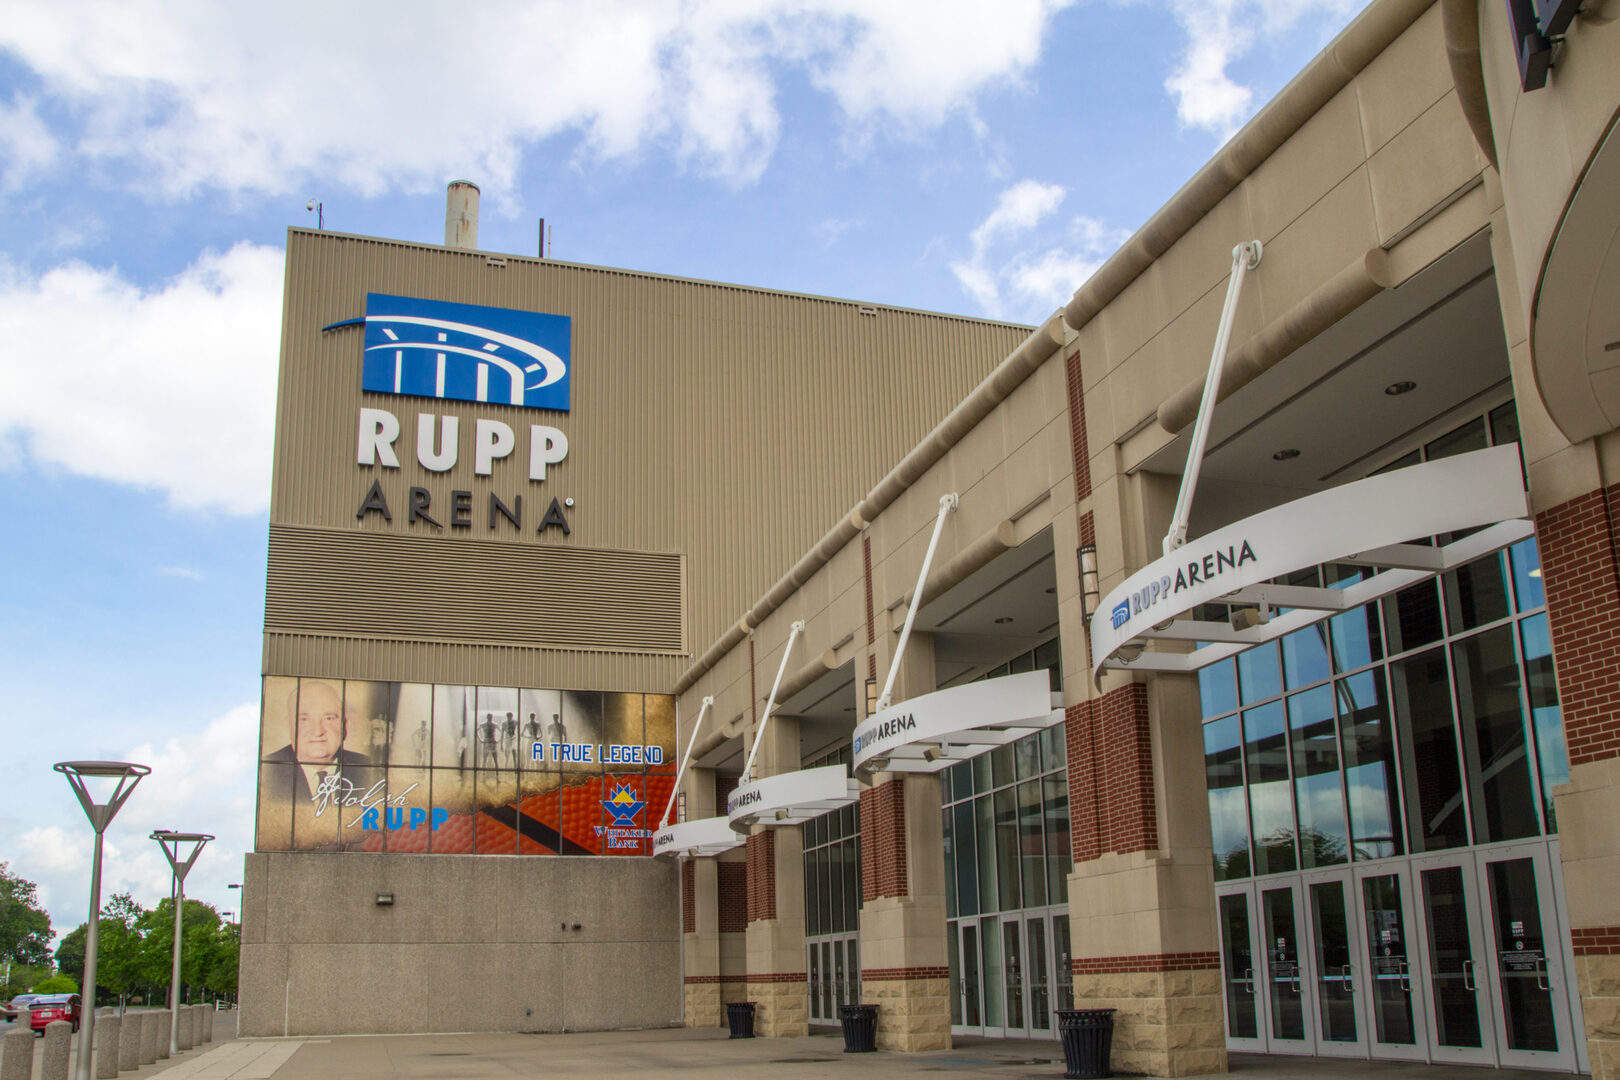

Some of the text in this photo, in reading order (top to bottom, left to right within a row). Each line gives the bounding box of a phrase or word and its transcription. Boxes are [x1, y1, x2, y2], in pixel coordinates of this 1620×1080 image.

[357, 407, 569, 481] RUPP
[356, 478, 570, 535] ARENA
[1132, 539, 1257, 615] RUPP ARENA
[878, 713, 916, 741] ARENA
[532, 742, 663, 764] A TRUE LEGEND
[739, 789, 762, 807] ARENA
[362, 806, 449, 831] RUPP
[607, 837, 639, 849] BANK
[658, 833, 674, 845] ARENA
